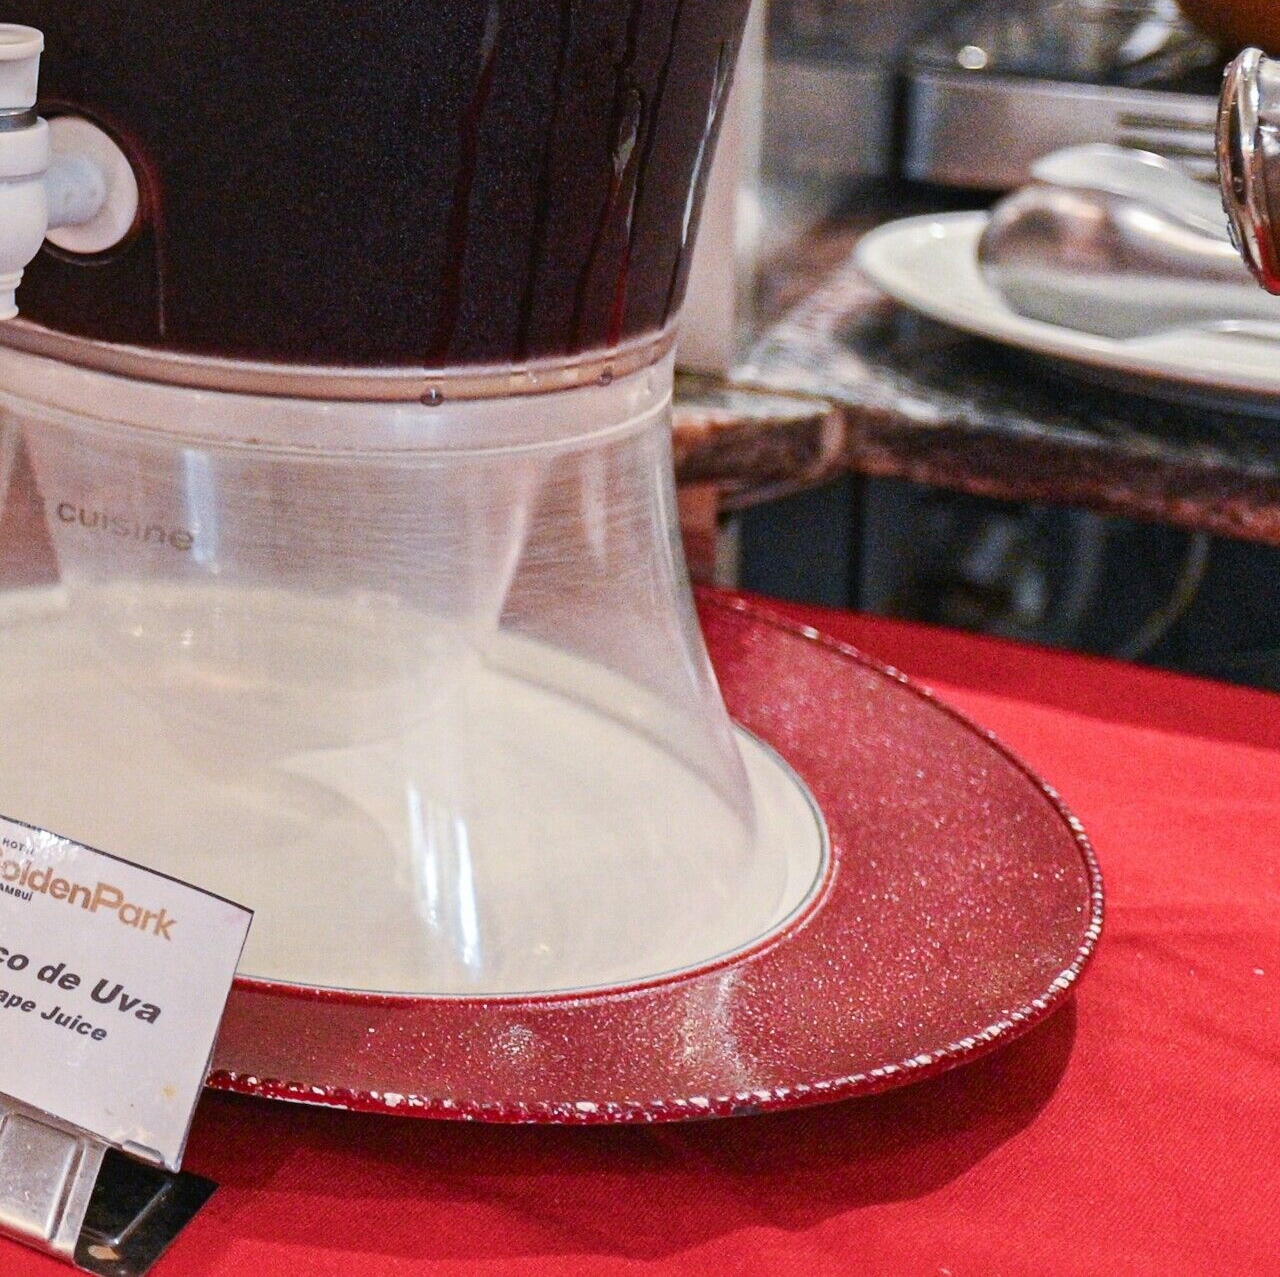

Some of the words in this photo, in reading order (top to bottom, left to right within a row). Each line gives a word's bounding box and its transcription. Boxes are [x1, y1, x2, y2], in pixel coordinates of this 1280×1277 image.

[56, 501, 194, 552] cuisine
[2, 836, 35, 856] HOT
[36, 962, 82, 991] de
[90, 978, 162, 1024] Uva
[40, 1006, 108, 1042] Juice
